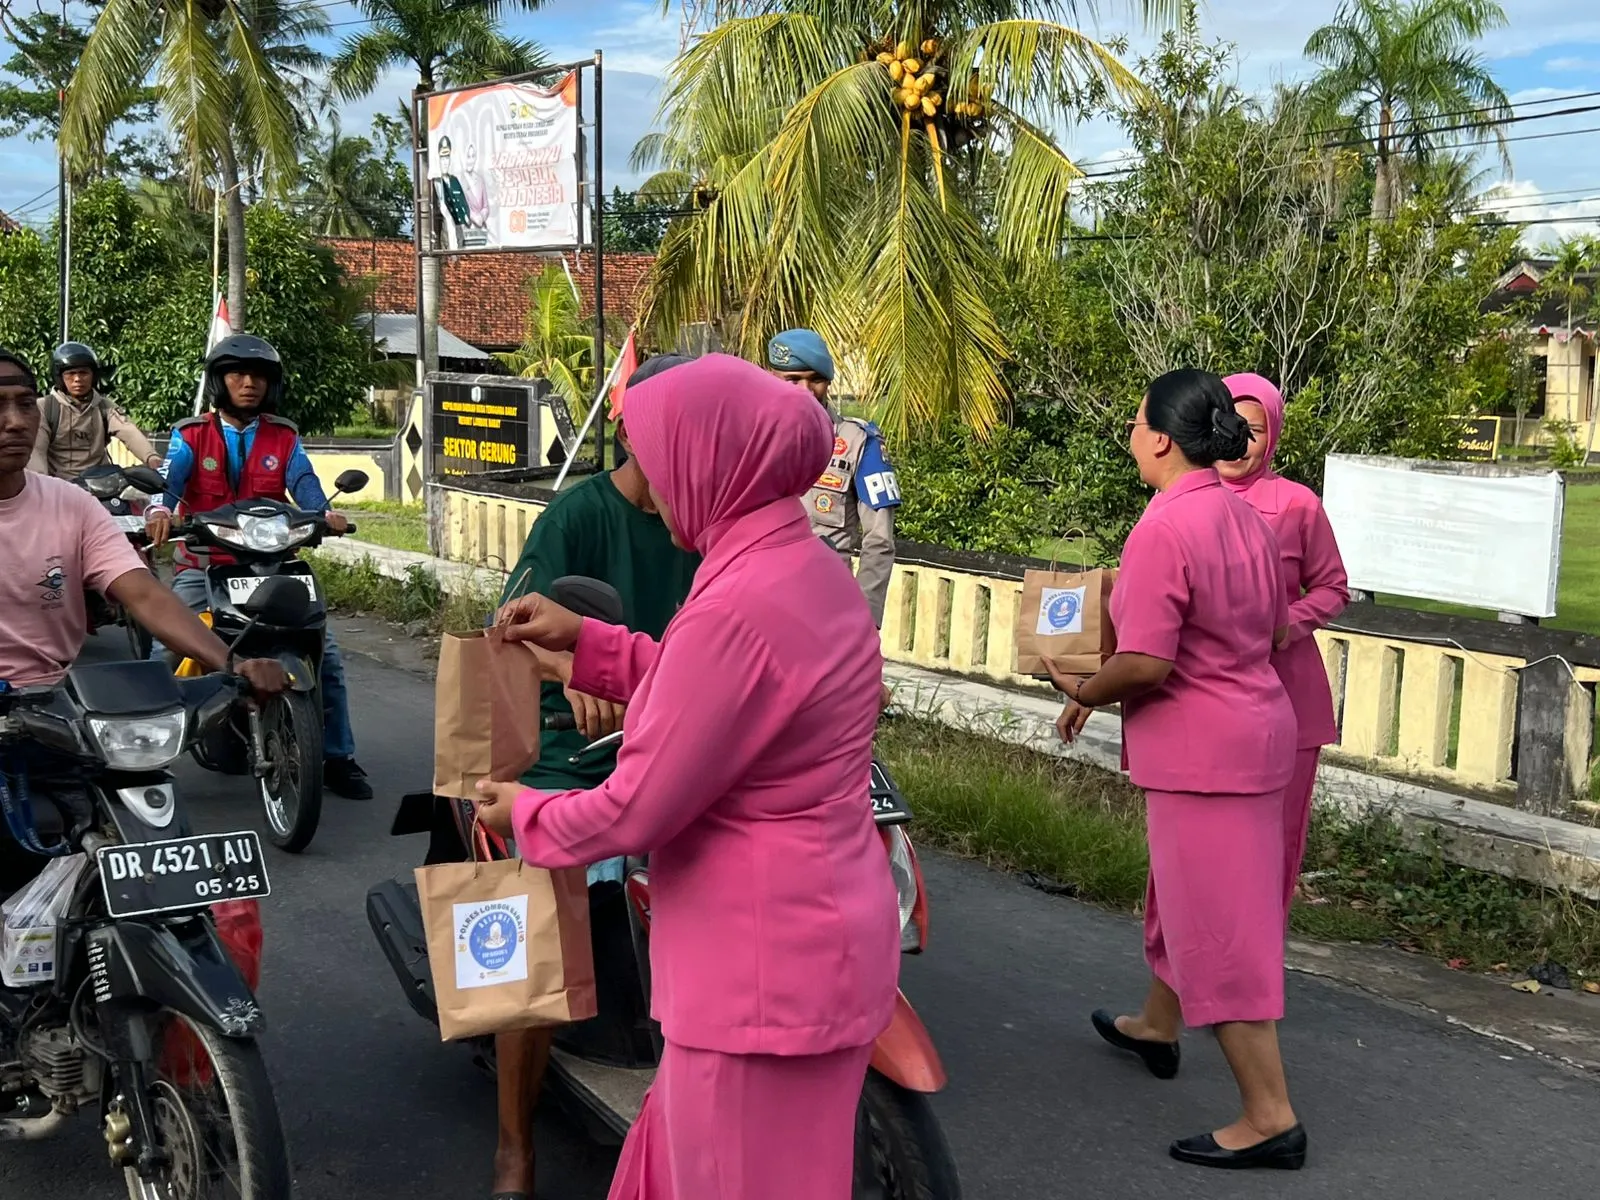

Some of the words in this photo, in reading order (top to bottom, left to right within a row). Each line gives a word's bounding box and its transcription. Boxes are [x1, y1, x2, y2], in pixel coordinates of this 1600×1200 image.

[443, 437, 477, 460] SEKTOR
[480, 441, 516, 465] GERUNG
[108, 851, 144, 880] DR
[152, 843, 213, 875] 4521
[224, 838, 253, 866] AU
[458, 910, 480, 940] POLRES
[479, 903, 510, 914] LOMBOK
